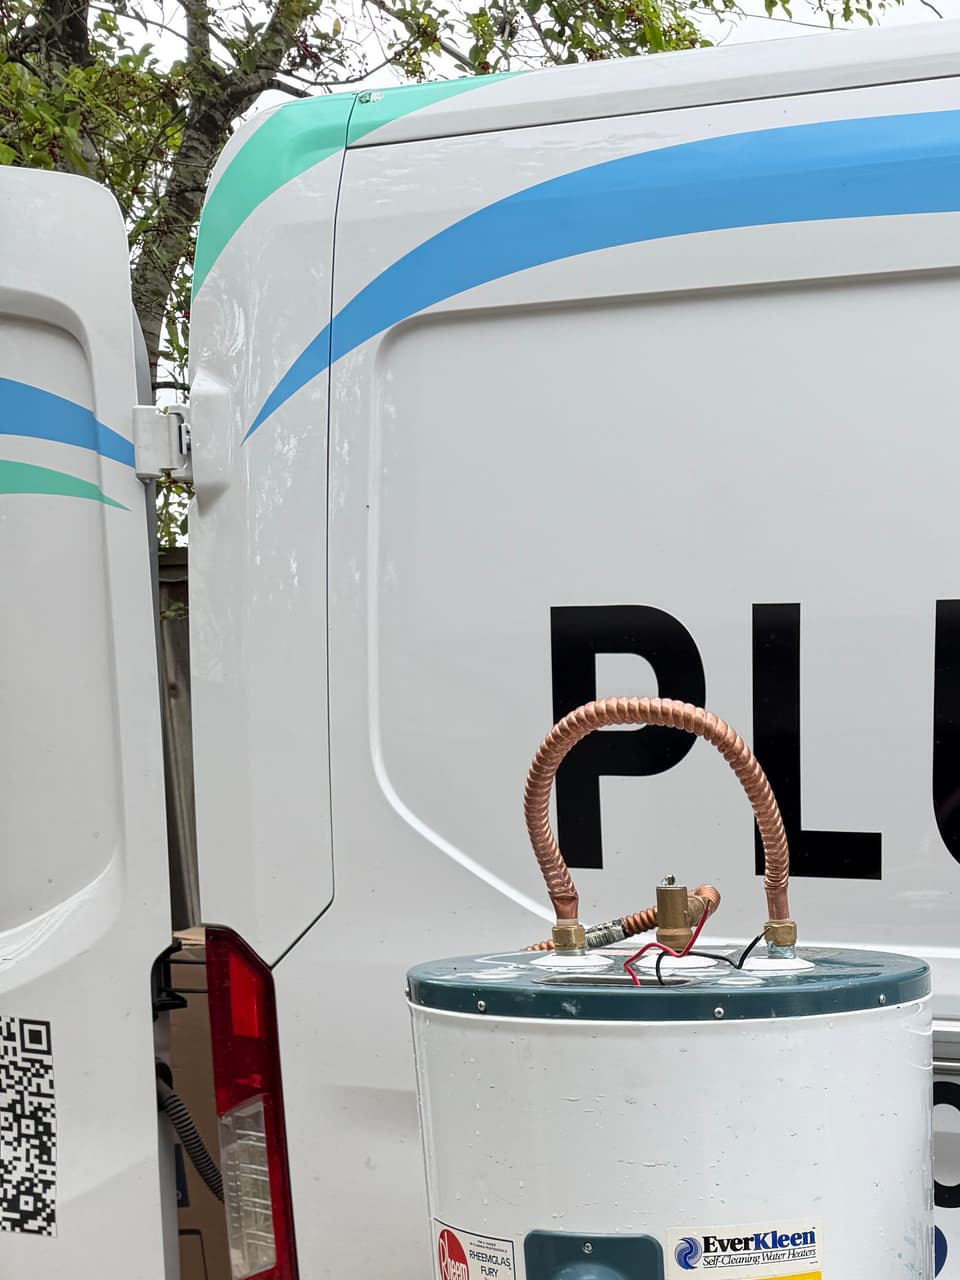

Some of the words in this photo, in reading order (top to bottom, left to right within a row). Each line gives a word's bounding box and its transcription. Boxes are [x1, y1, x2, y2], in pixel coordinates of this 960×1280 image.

[702, 1230, 816, 1253] EverKleen
[703, 1255, 760, 1267] Self-Cleaning
[762, 1252, 786, 1263] Water
[788, 1249, 816, 1260] Heaters
[480, 1265, 498, 1278] FURY
